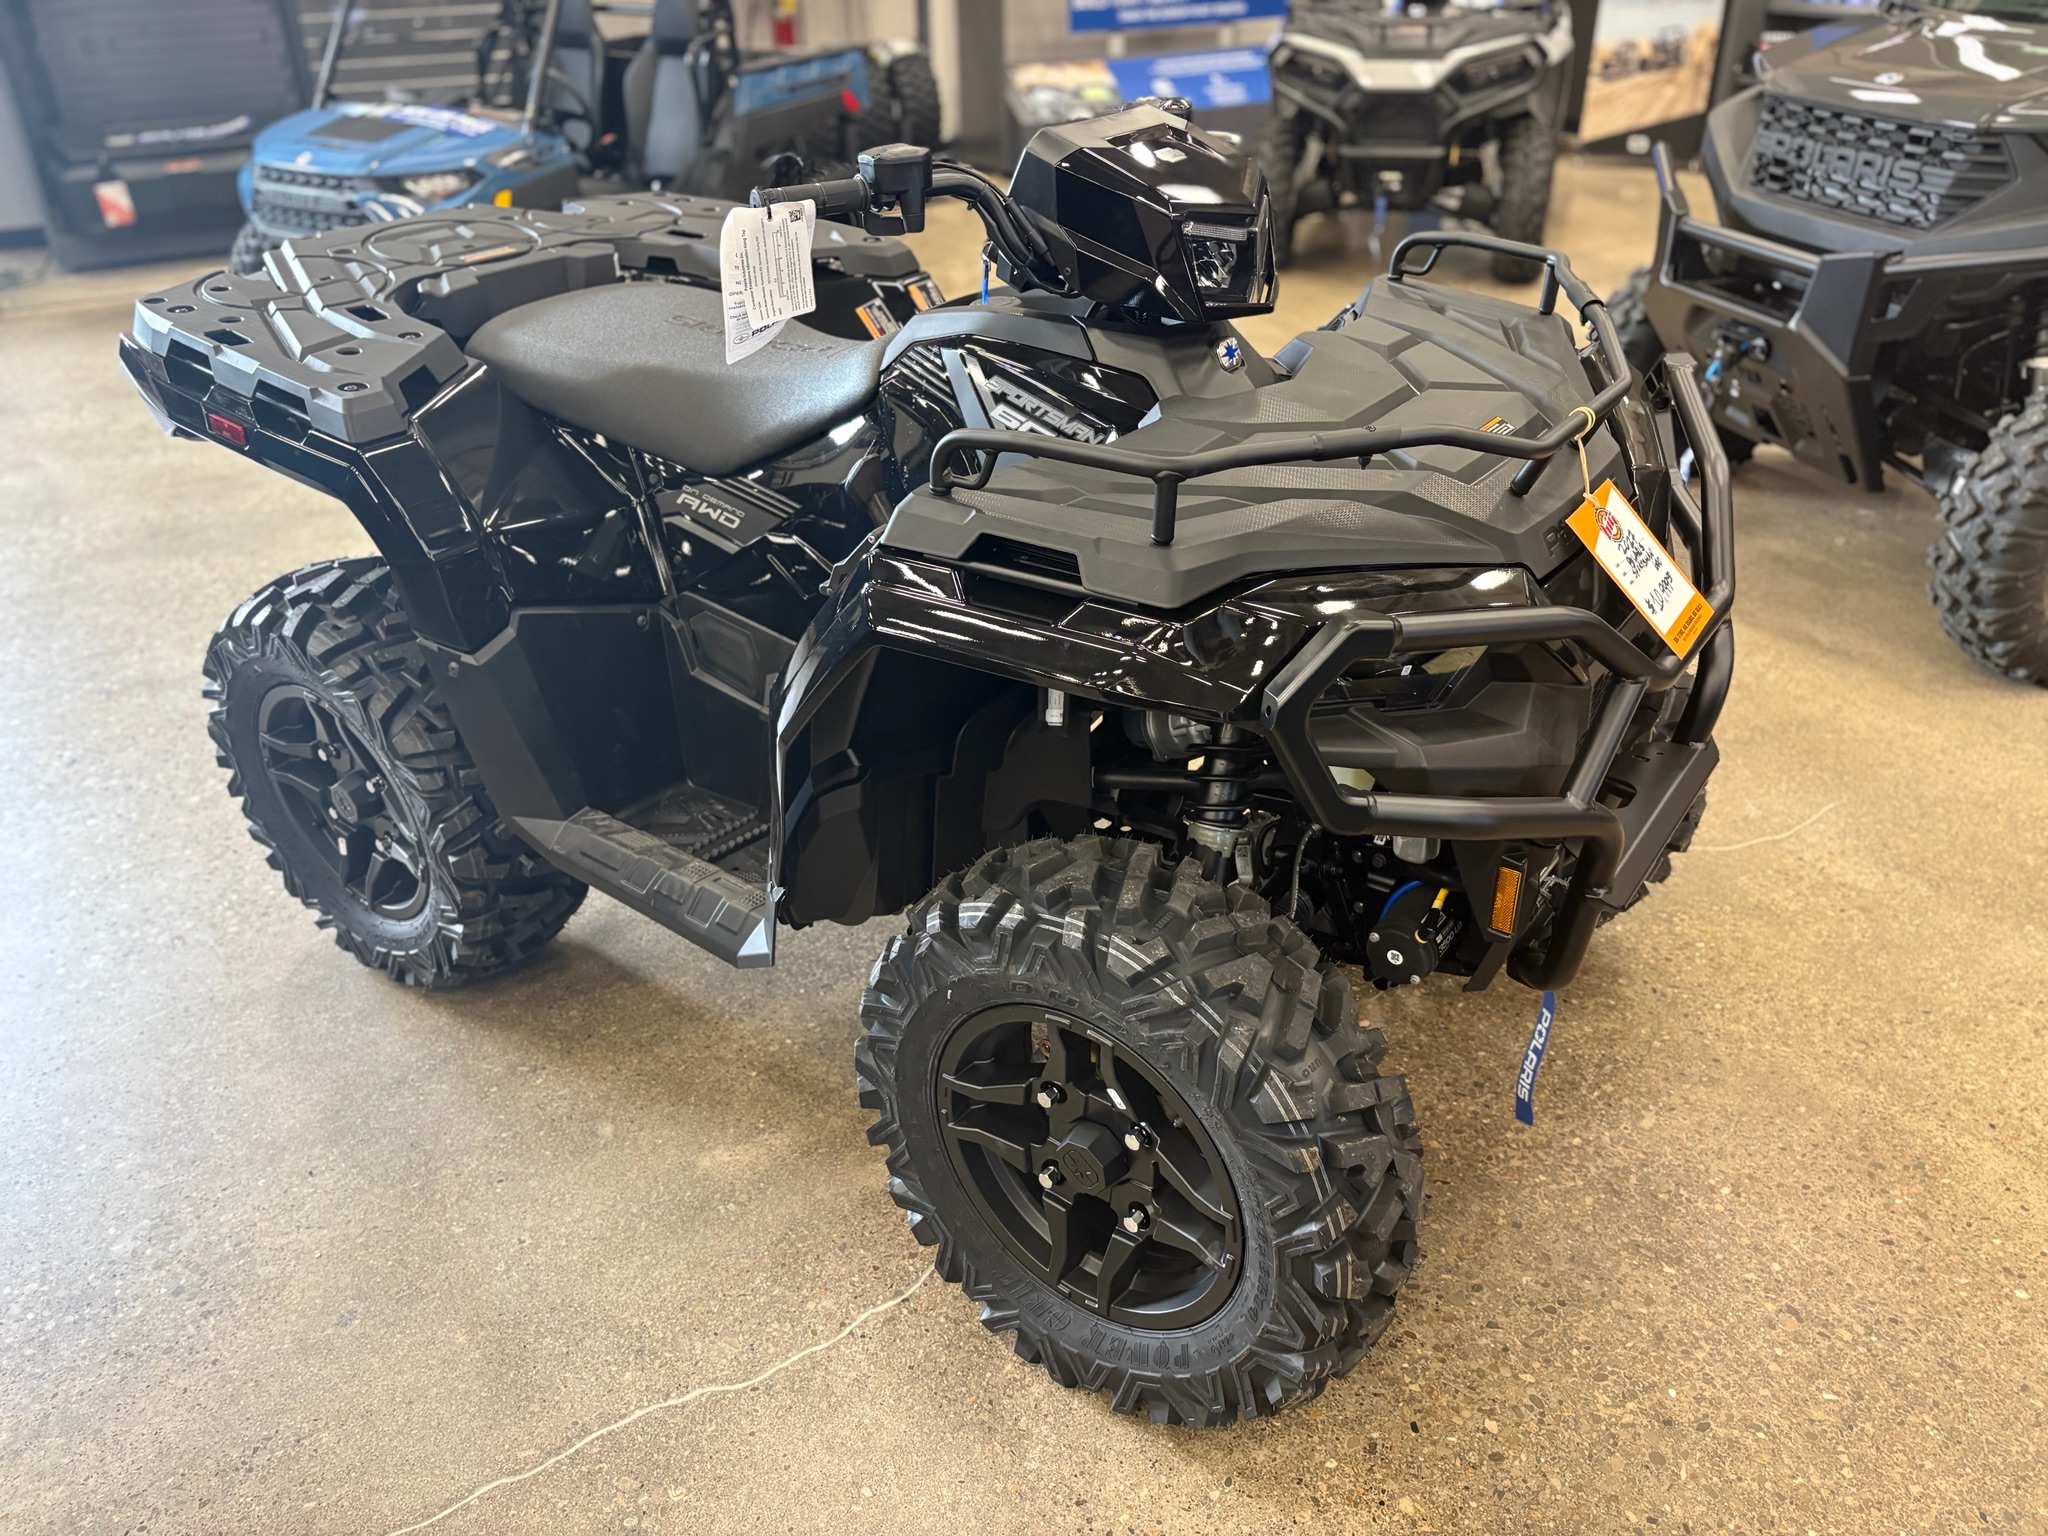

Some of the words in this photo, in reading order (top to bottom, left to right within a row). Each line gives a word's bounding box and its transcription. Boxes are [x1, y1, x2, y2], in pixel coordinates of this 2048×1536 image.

[1765, 131, 1922, 192] POLARIS
[985, 374, 1105, 445] SPORTSMAN
[676, 493, 741, 529] AWD
[702, 493, 745, 518] DEMAND
[1517, 1007, 1552, 1103] POLARIS
